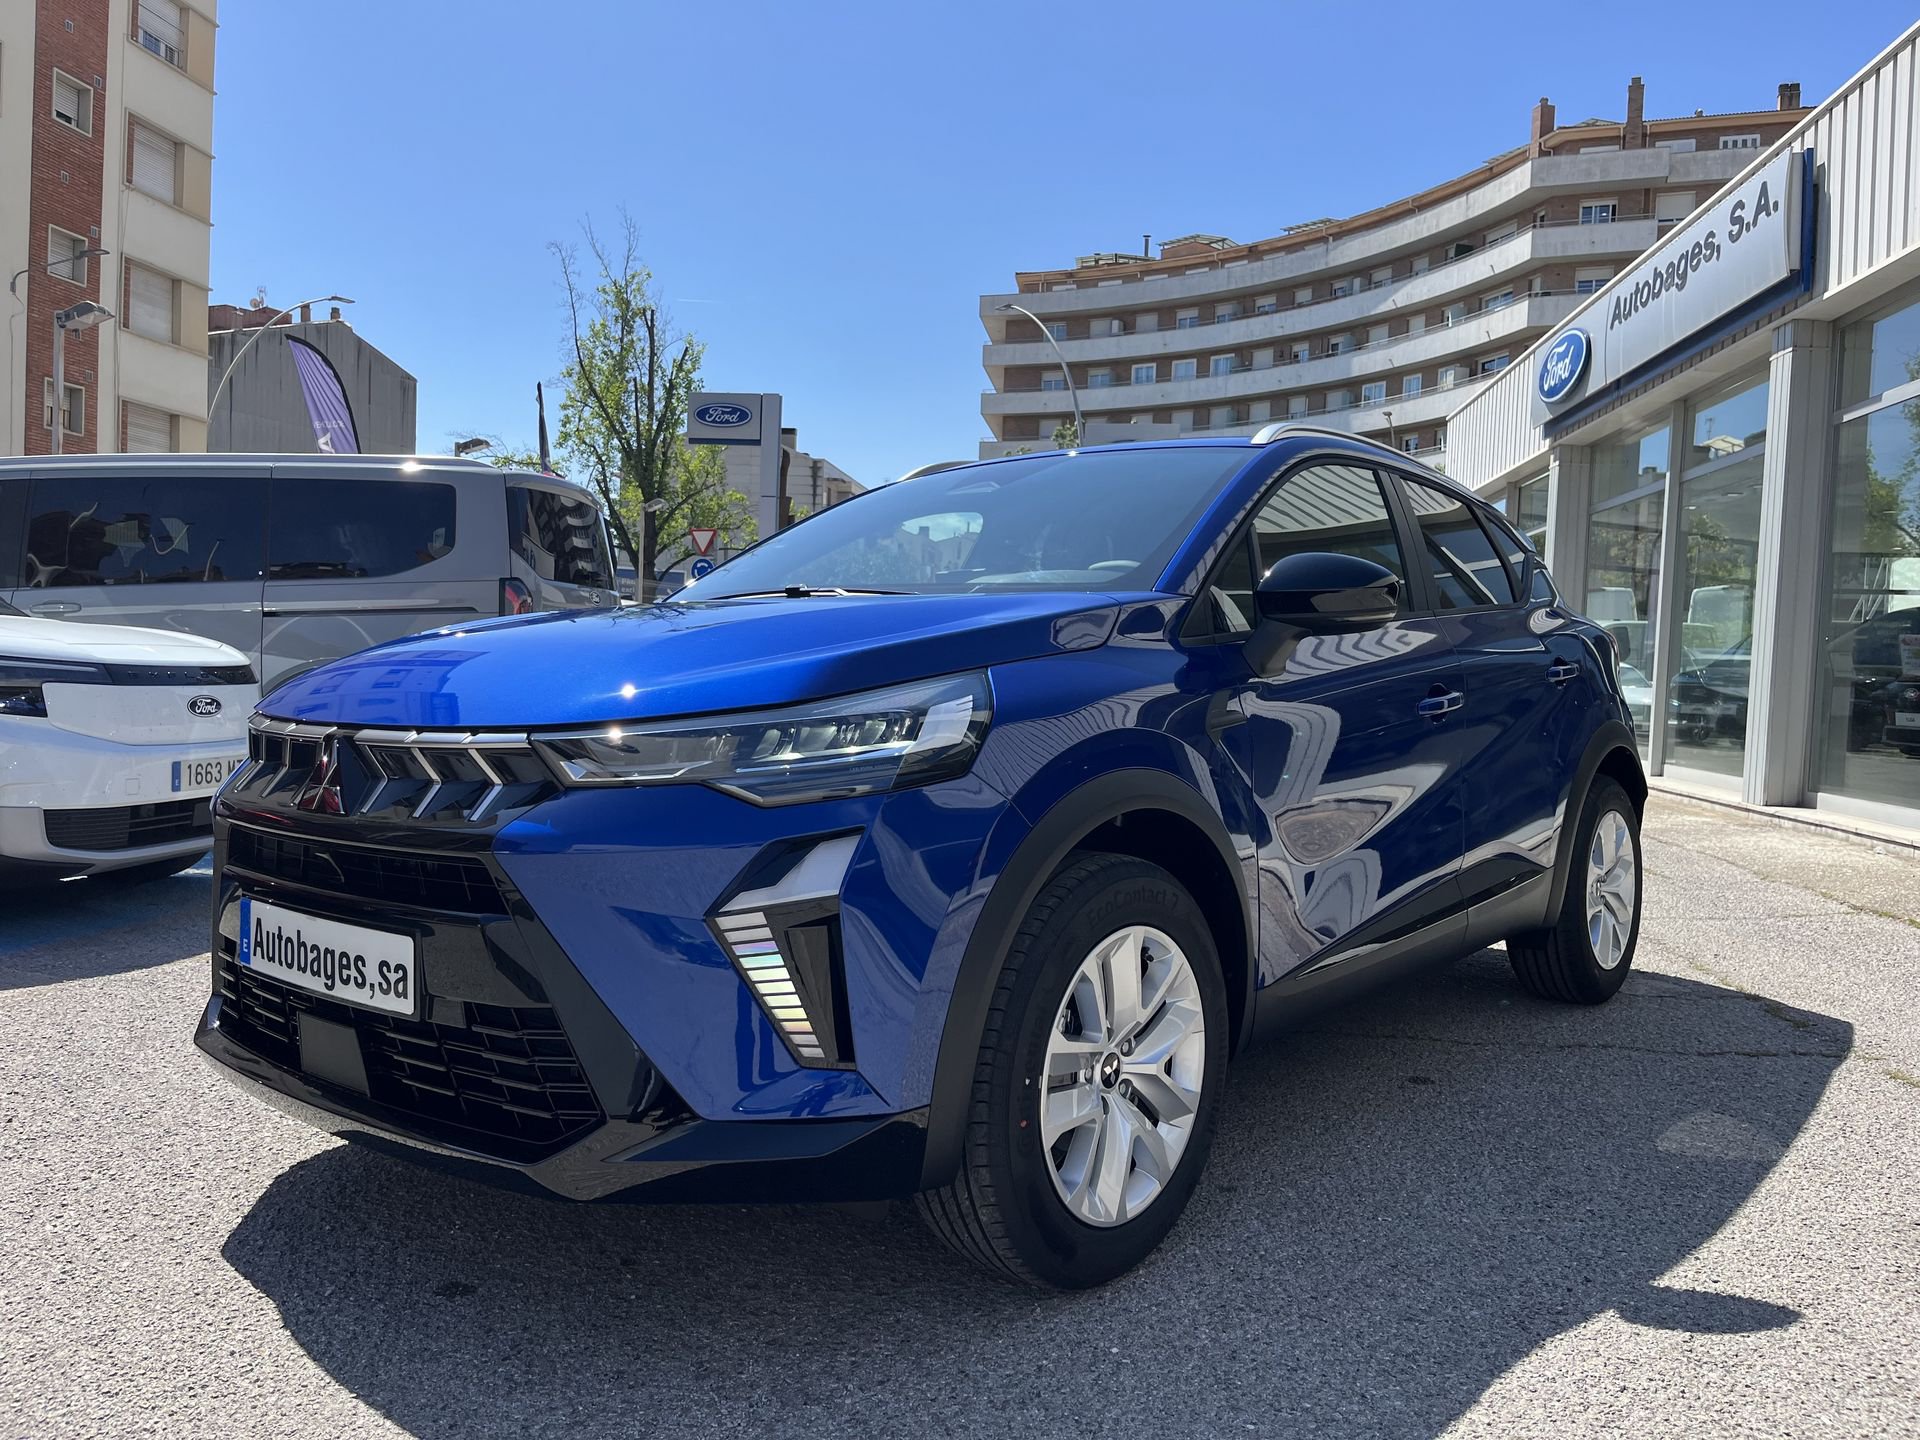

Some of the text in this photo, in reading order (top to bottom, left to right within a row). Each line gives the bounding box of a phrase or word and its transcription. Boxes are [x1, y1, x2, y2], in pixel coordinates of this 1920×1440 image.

[1610, 181, 1779, 330] Autobages, S.A.
[1543, 342, 1574, 392] Ford
[705, 407, 741, 422] Ford
[195, 698, 218, 713] Ford
[187, 761, 222, 786] 1663
[1087, 885, 1168, 929] EcoContact
[243, 939, 248, 952] E
[253, 917, 409, 1000] Autobages,sa
